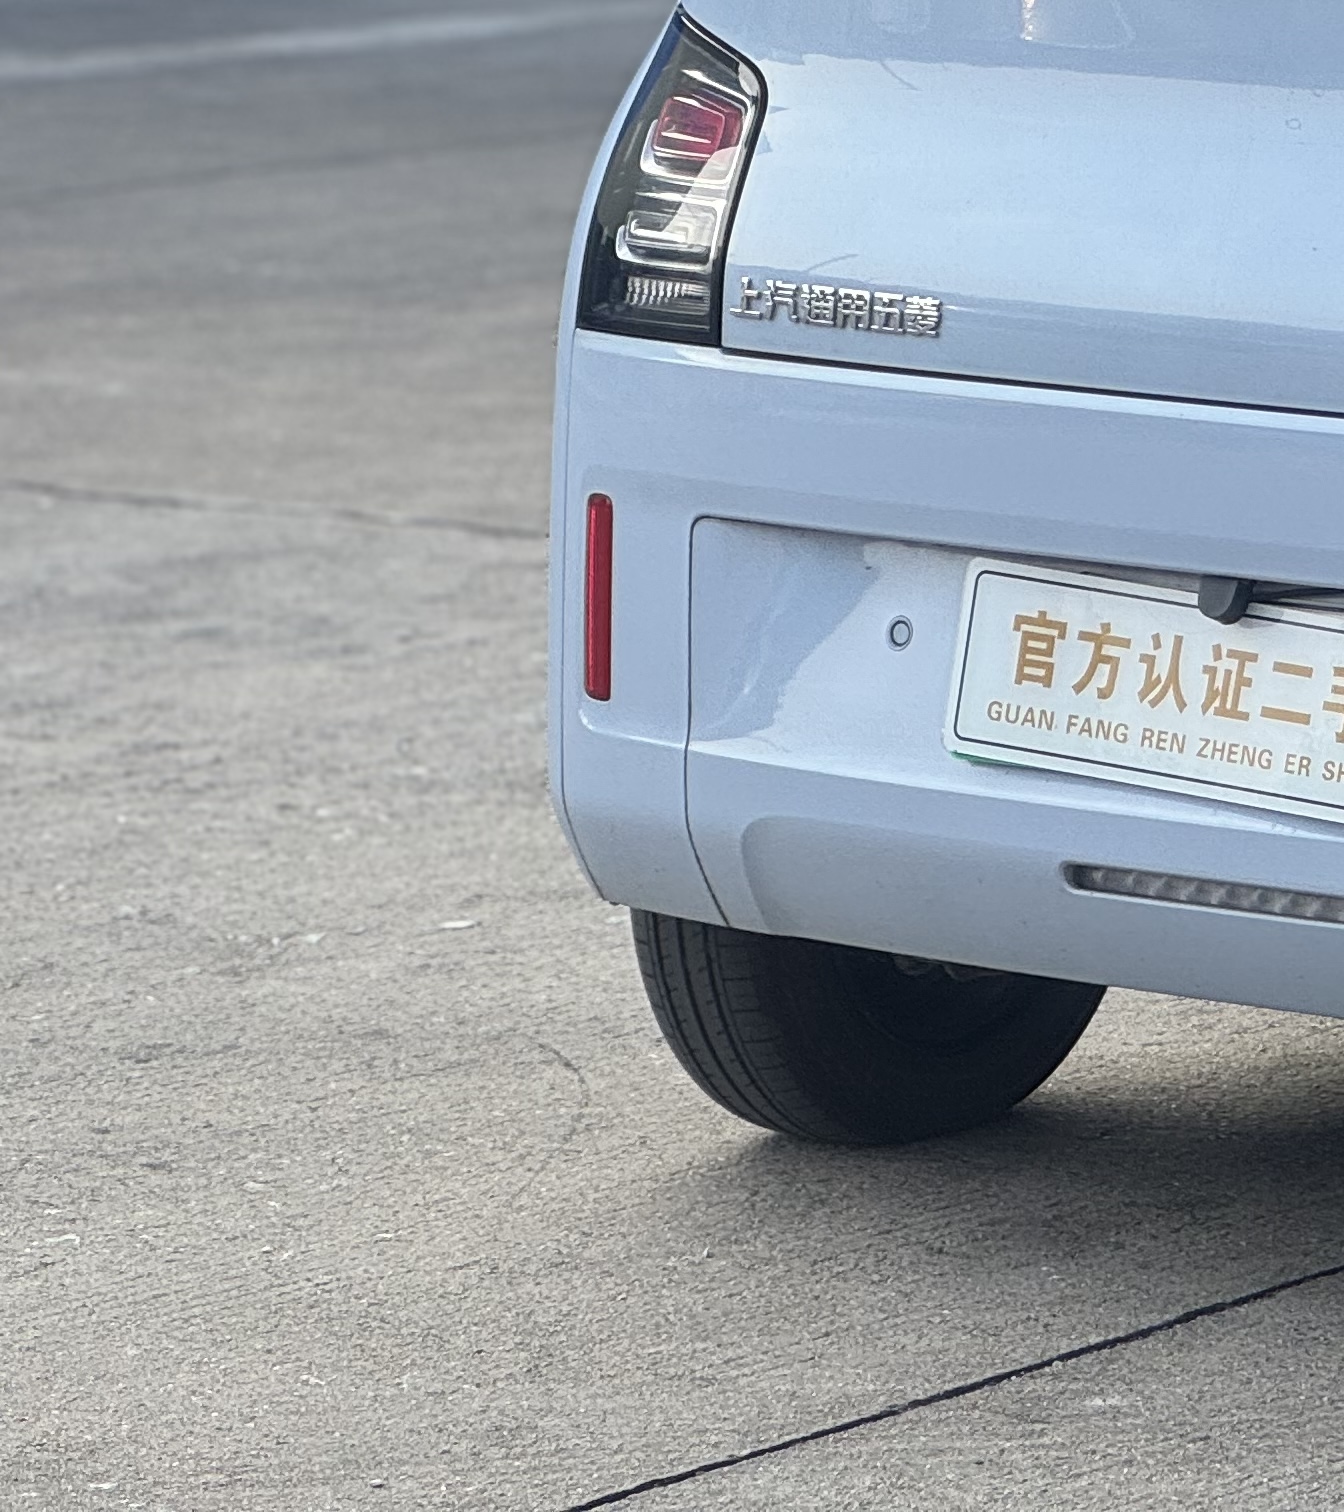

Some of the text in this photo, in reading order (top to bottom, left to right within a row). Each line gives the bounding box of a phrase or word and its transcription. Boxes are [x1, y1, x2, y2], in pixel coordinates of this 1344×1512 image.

[729, 275, 943, 338] 上汽通用五菱
[986, 700, 1055, 730] GUAN
[1066, 713, 1129, 745] FANG
[1140, 727, 1186, 755] REN
[1196, 738, 1273, 771] ZHENG
[1284, 753, 1312, 778] ER
